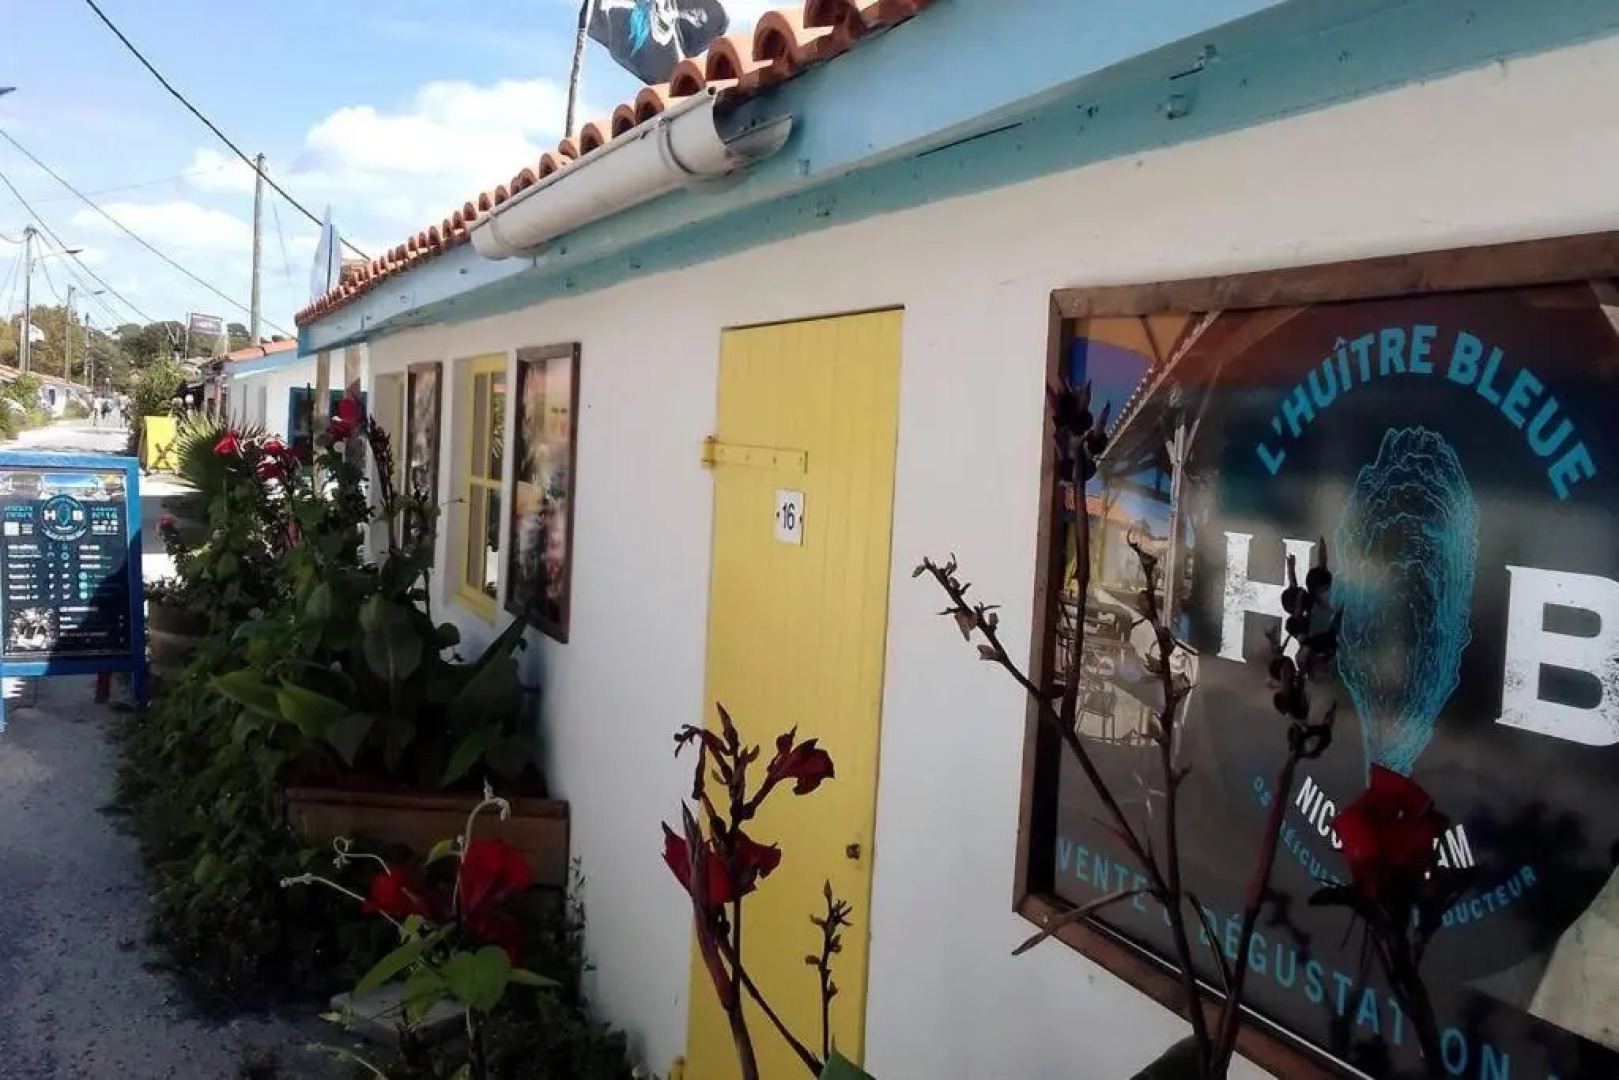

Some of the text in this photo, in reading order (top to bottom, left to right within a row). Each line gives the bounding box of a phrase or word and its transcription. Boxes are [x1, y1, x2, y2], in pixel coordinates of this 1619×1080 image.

[1256, 325, 1598, 500] L'HUÎTRE BLEUE
[782, 502, 795, 531] 16
[1216, 531, 1619, 746] H B
[1057, 836, 1510, 1080] VENTE DÉGUSTATON
